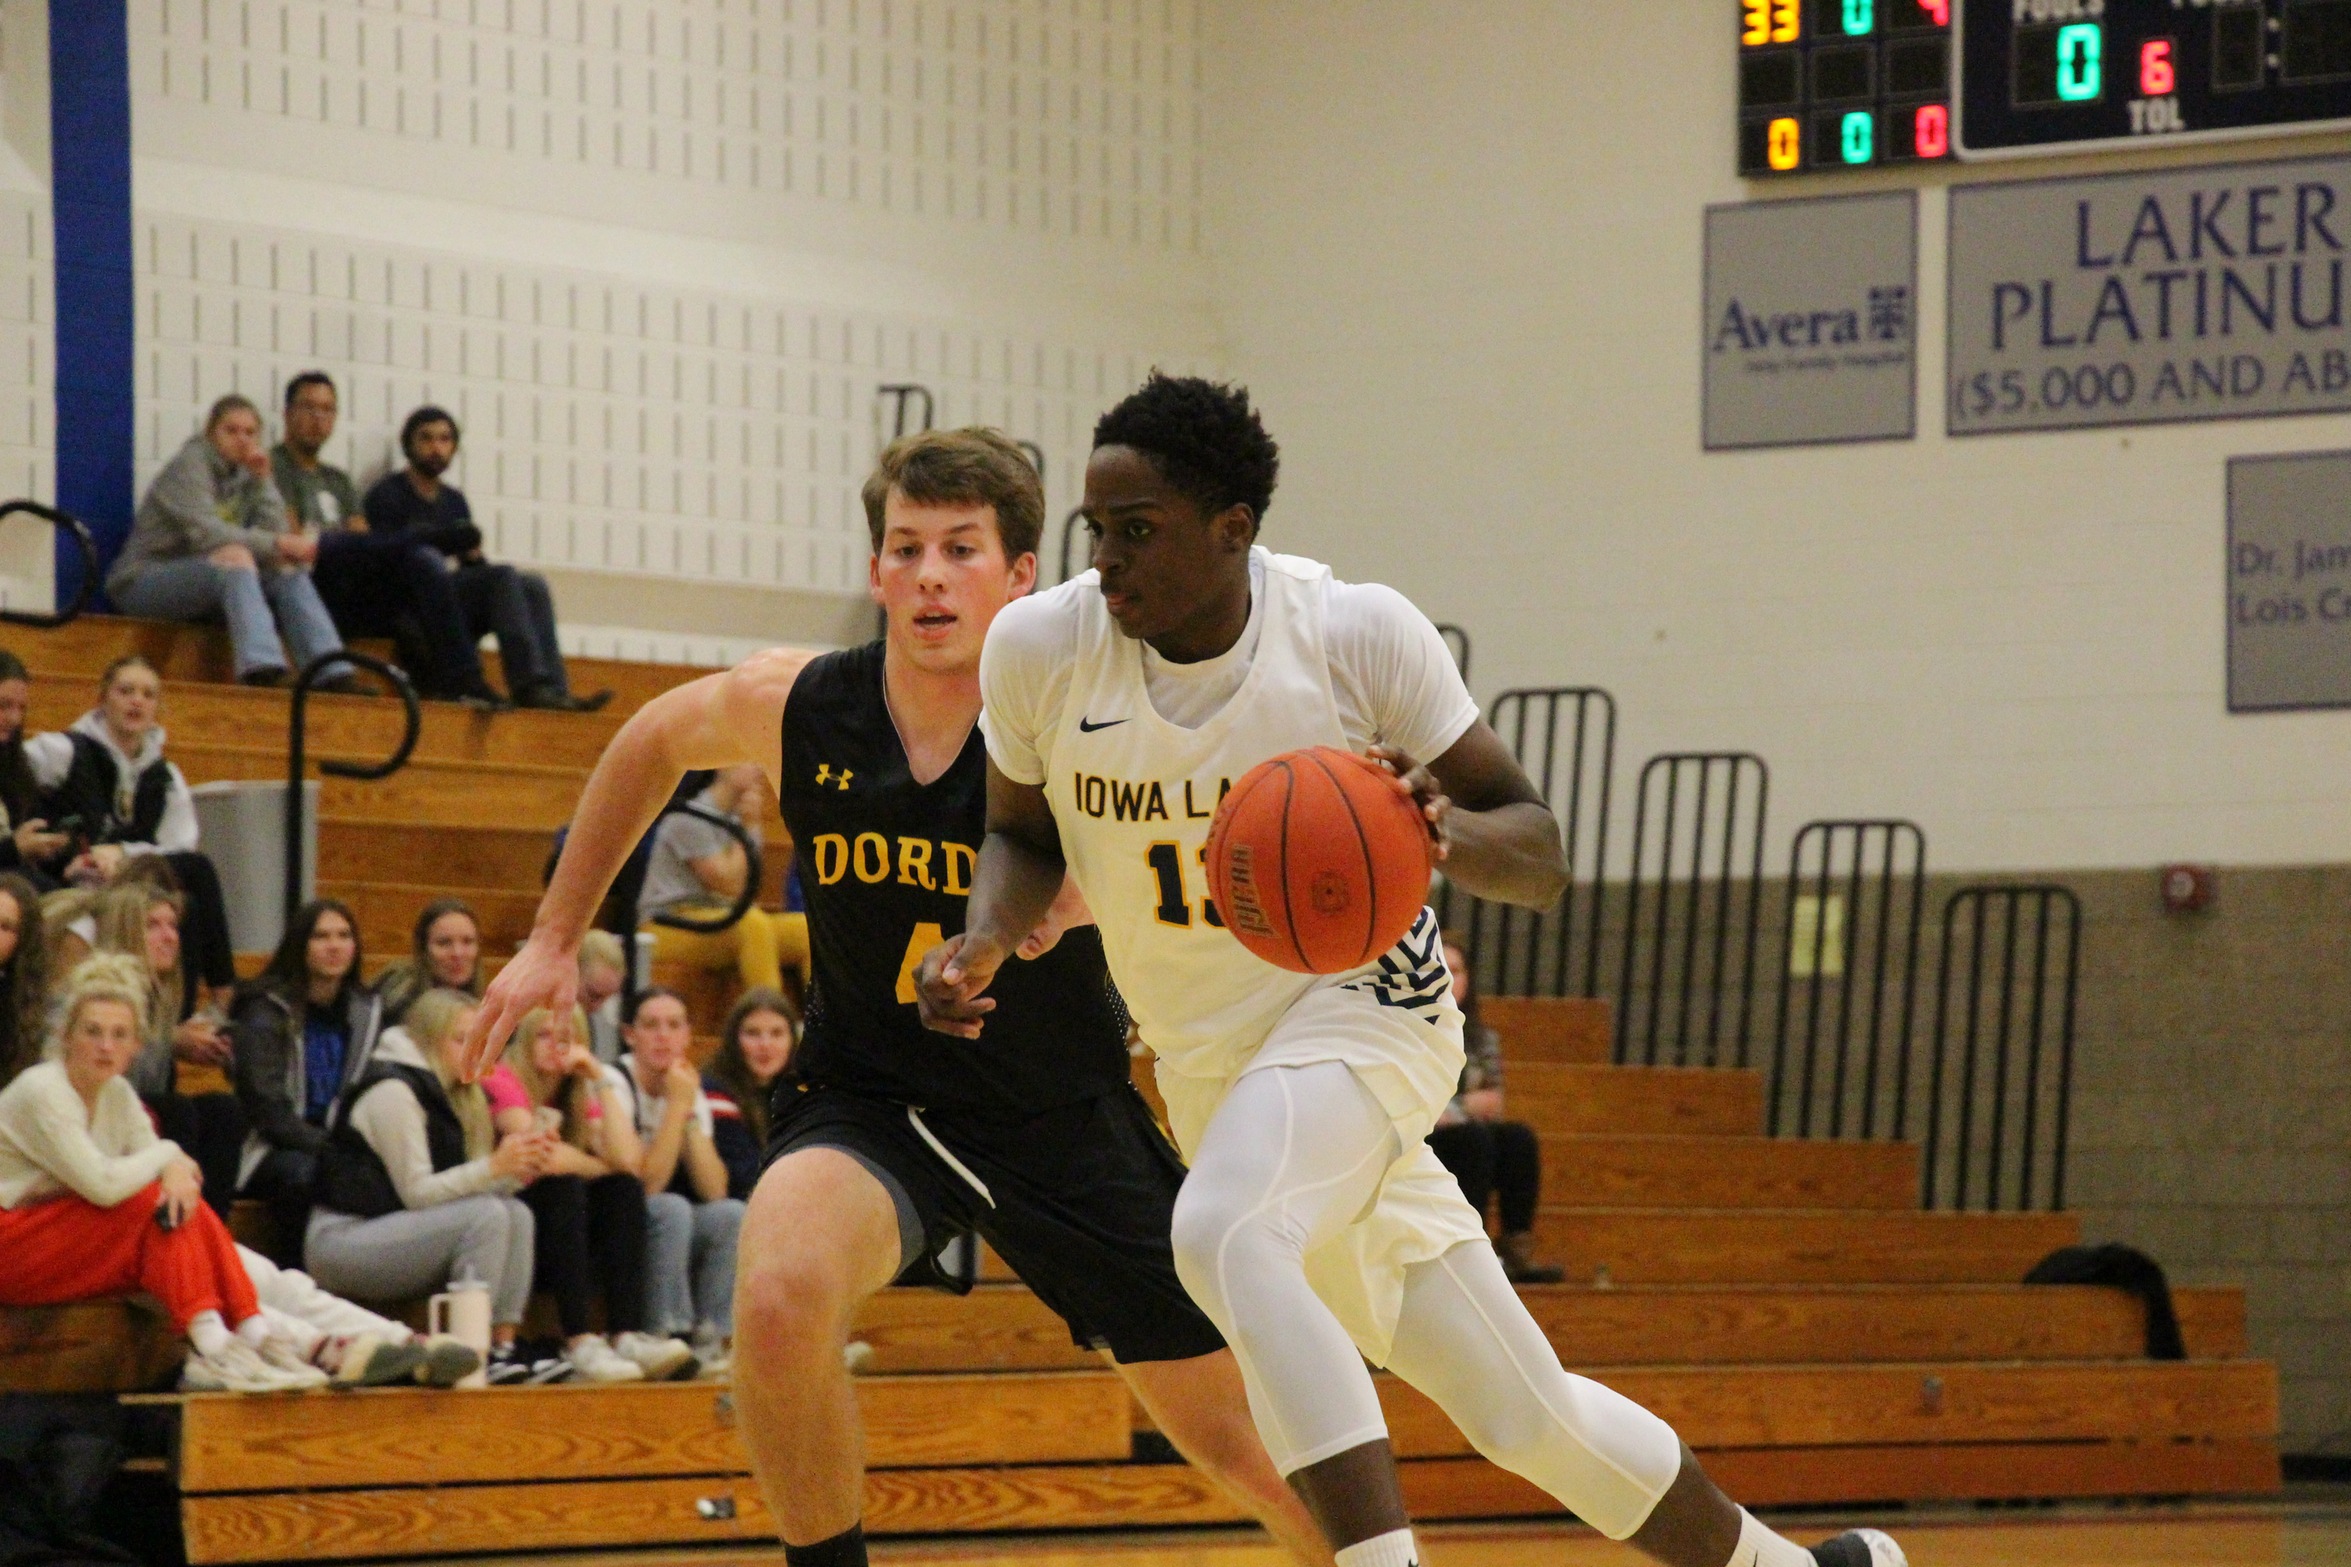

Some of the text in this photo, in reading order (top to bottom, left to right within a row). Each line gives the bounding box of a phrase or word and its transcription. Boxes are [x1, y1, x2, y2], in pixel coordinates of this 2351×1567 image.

[2058, 23, 2100, 101] 0
[2141, 40, 2174, 95] 6
[1768, 104, 1948, 171] 0 0 0
[2128, 100, 2185, 135] TOL
[2077, 182, 2343, 268] LAKER
[1713, 297, 1858, 351] Avera
[1992, 259, 2342, 351] PLATINU
[2153, 354, 2265, 400] AND
[2282, 348, 2351, 394] AB
[1075, 772, 1169, 821] IOWA
[812, 832, 977, 896] DORD
[1144, 840, 1228, 930] 1
